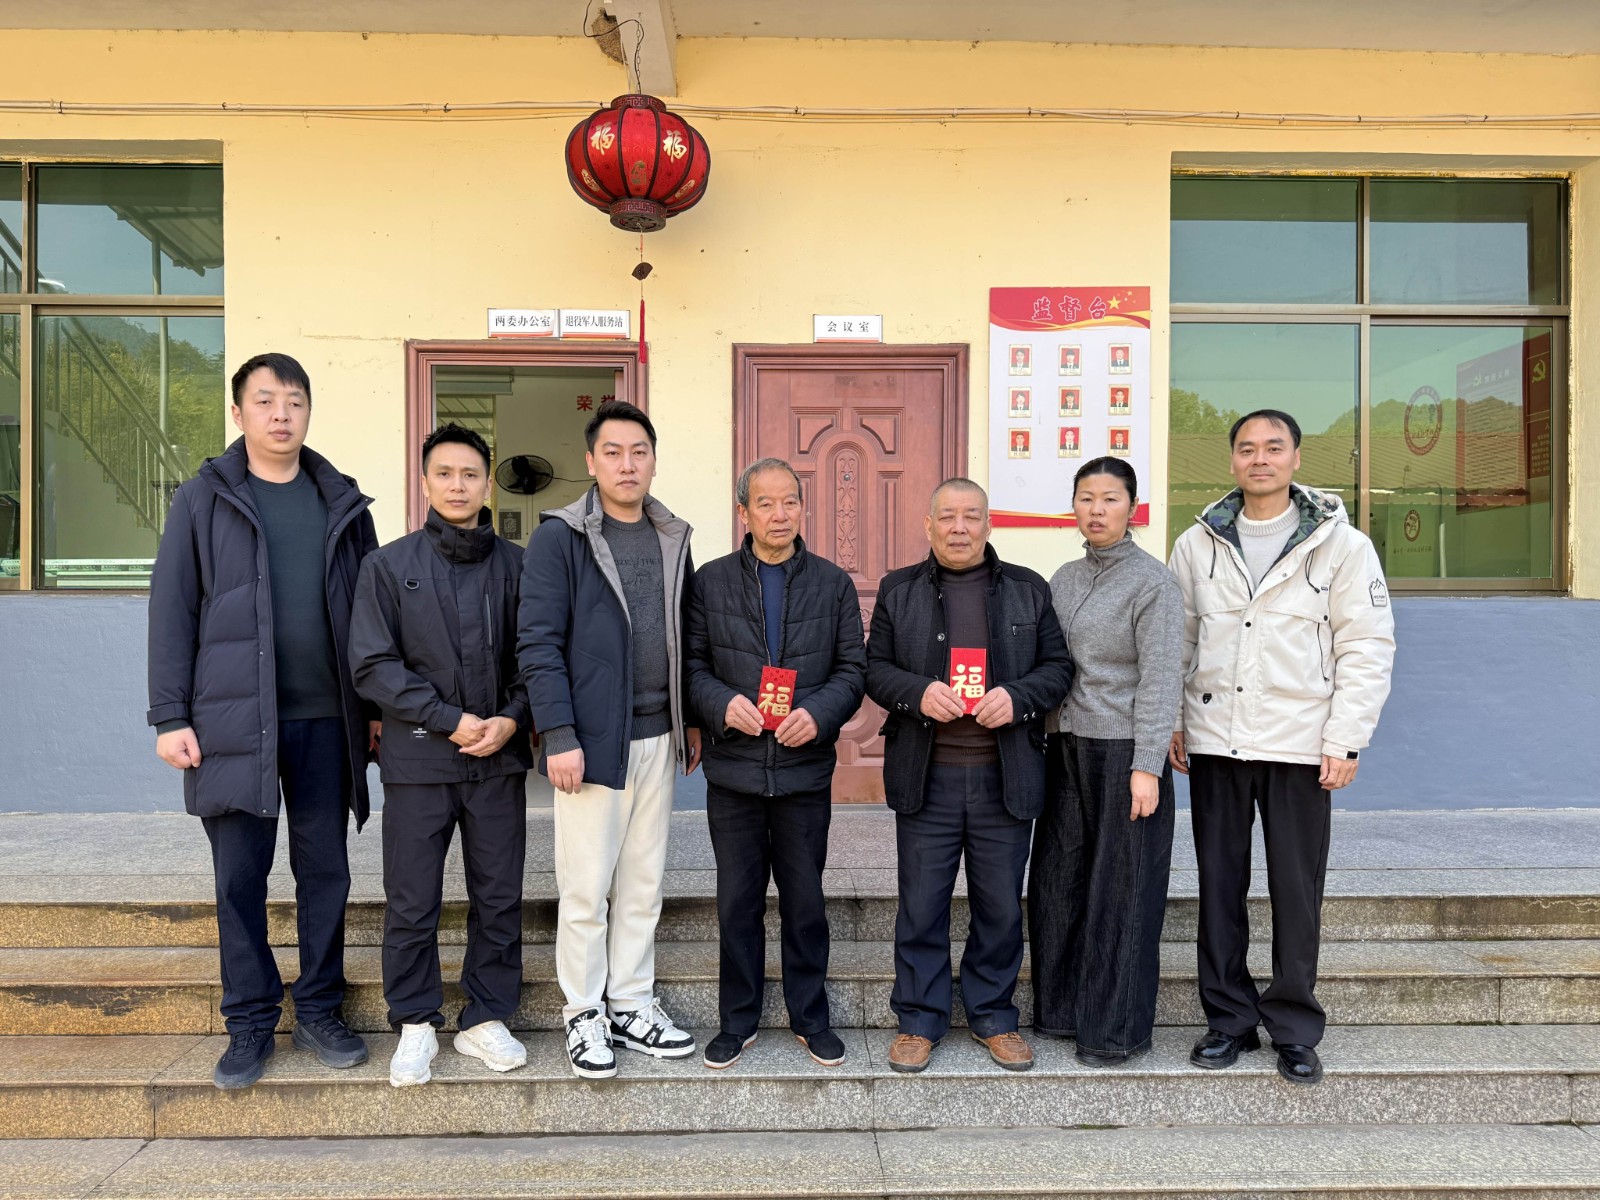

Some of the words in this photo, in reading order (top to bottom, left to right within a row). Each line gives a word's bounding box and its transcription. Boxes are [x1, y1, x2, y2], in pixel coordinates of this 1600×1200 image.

[590, 121, 615, 155] 福
[662, 129, 687, 163] 福
[495, 315, 551, 328] 两委办公室
[565, 315, 623, 328] 退役军人服务站
[1031, 295, 1107, 322] 监督台
[827, 320, 870, 333] 会议室
[952, 663, 986, 698] 福
[758, 682, 791, 716] 福
